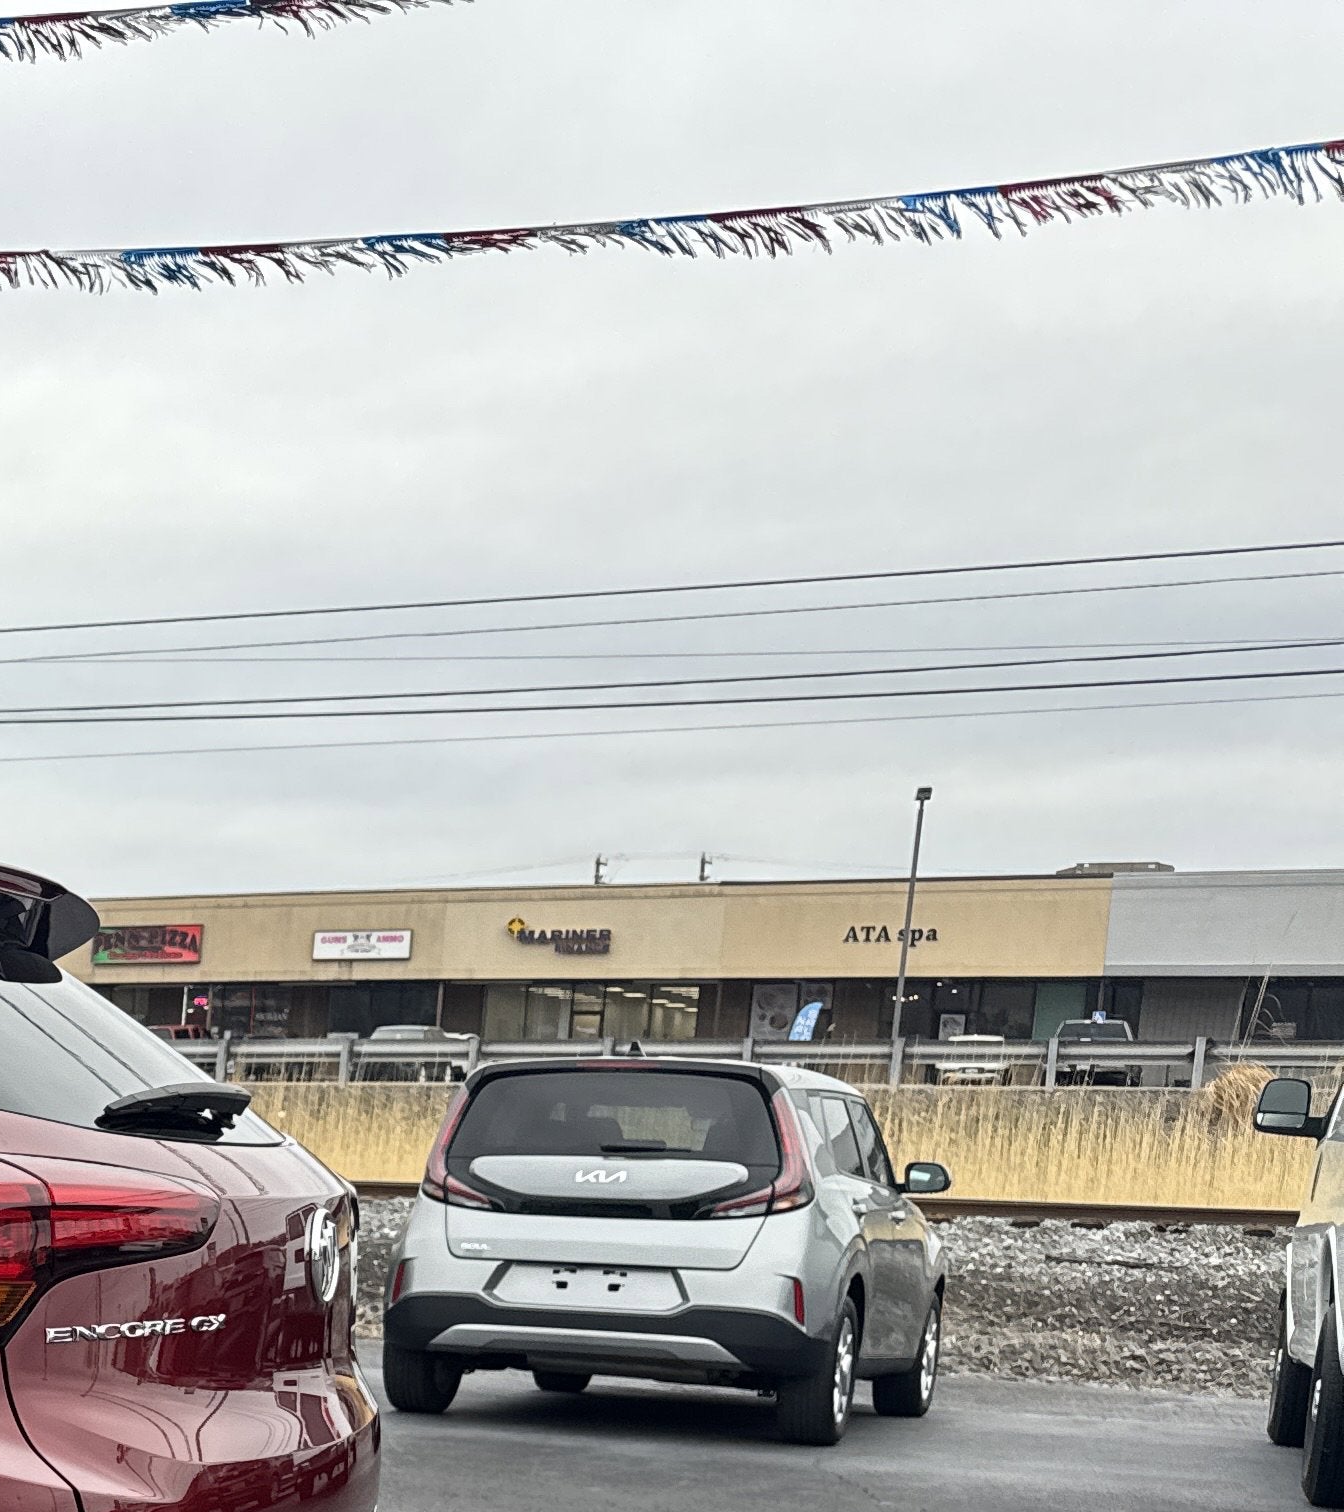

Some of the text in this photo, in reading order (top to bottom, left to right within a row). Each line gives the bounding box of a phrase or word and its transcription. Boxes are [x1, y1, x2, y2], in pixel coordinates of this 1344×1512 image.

[517, 929, 612, 945] MARINER
[843, 925, 939, 947] ATA spa
[575, 1169, 628, 1184] KIA
[45, 1313, 227, 1344] ENCORE GX
